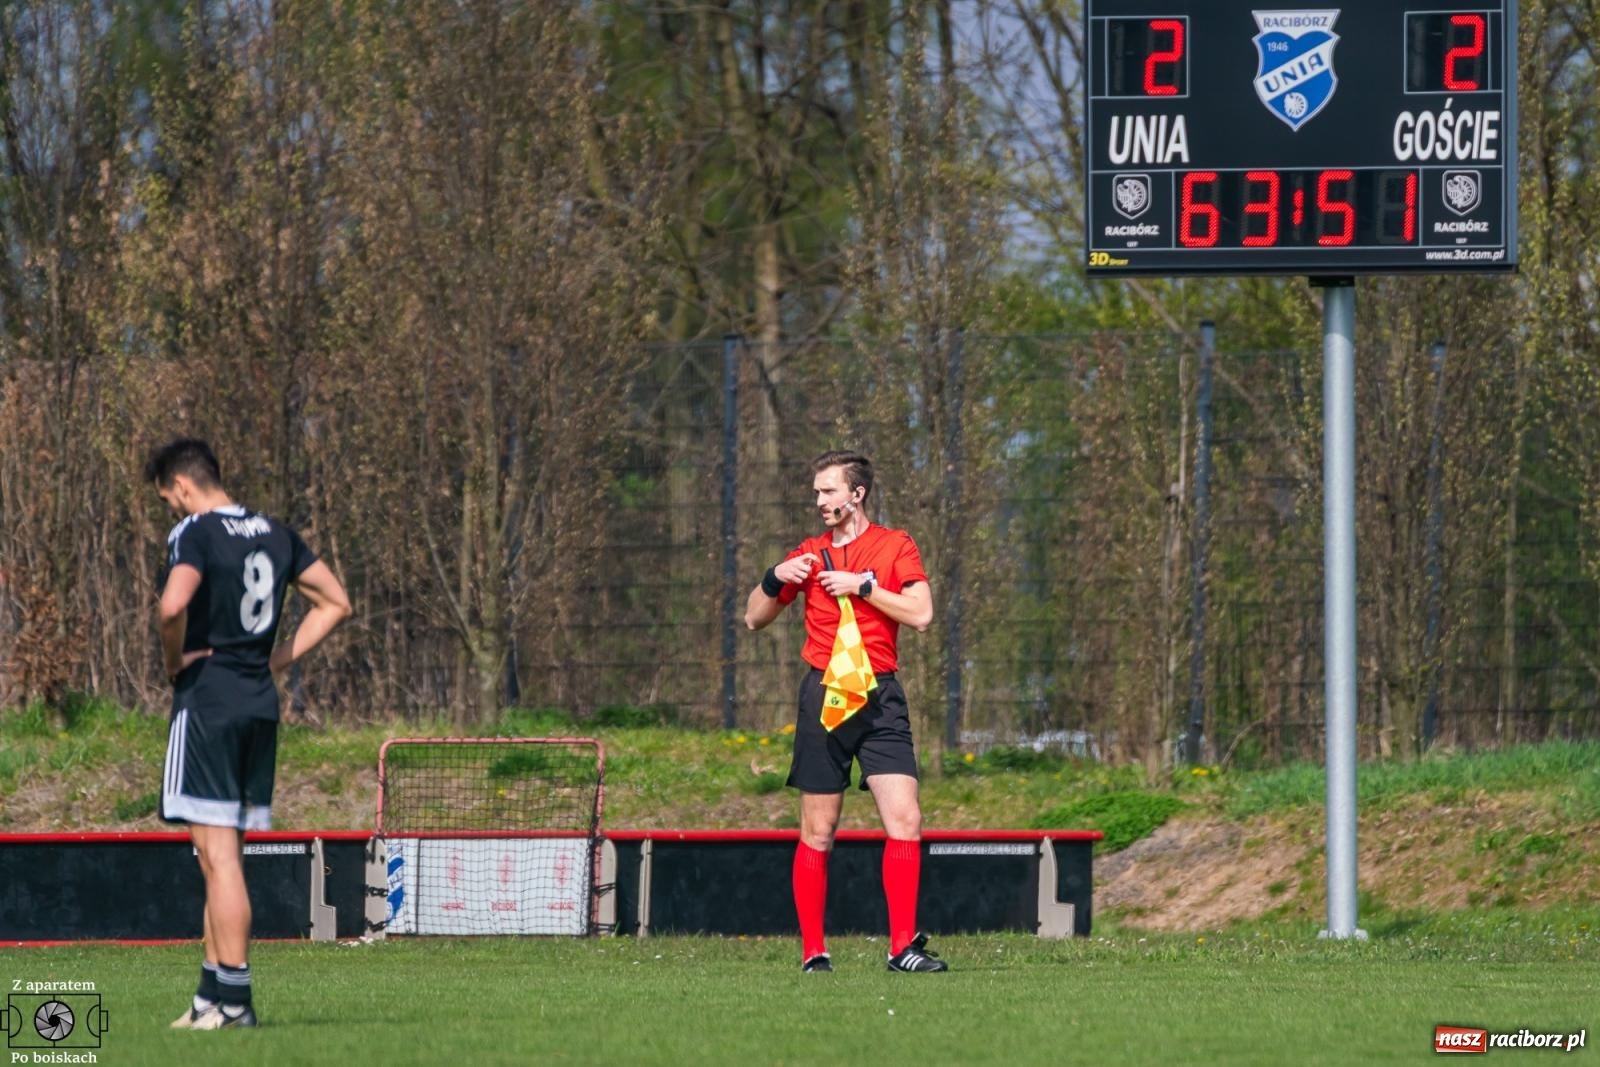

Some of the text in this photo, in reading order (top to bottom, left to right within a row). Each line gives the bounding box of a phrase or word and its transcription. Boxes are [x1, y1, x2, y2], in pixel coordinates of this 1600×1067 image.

[1263, 15, 1328, 28] RACIBÓRZ
[1144, 20, 1184, 96] 2
[1264, 52, 1324, 93] UNIA
[1444, 15, 1485, 91] 2
[1109, 114, 1190, 164] UNIA
[1393, 97, 1500, 161] GOŚCIE
[1104, 222, 1160, 236] RACIBÓRZ
[1434, 219, 1489, 232] RACIBÓRZ
[1089, 252, 1110, 266] 3D
[1426, 249, 1504, 261] www.3d.com.pl
[240, 551, 273, 634] 8
